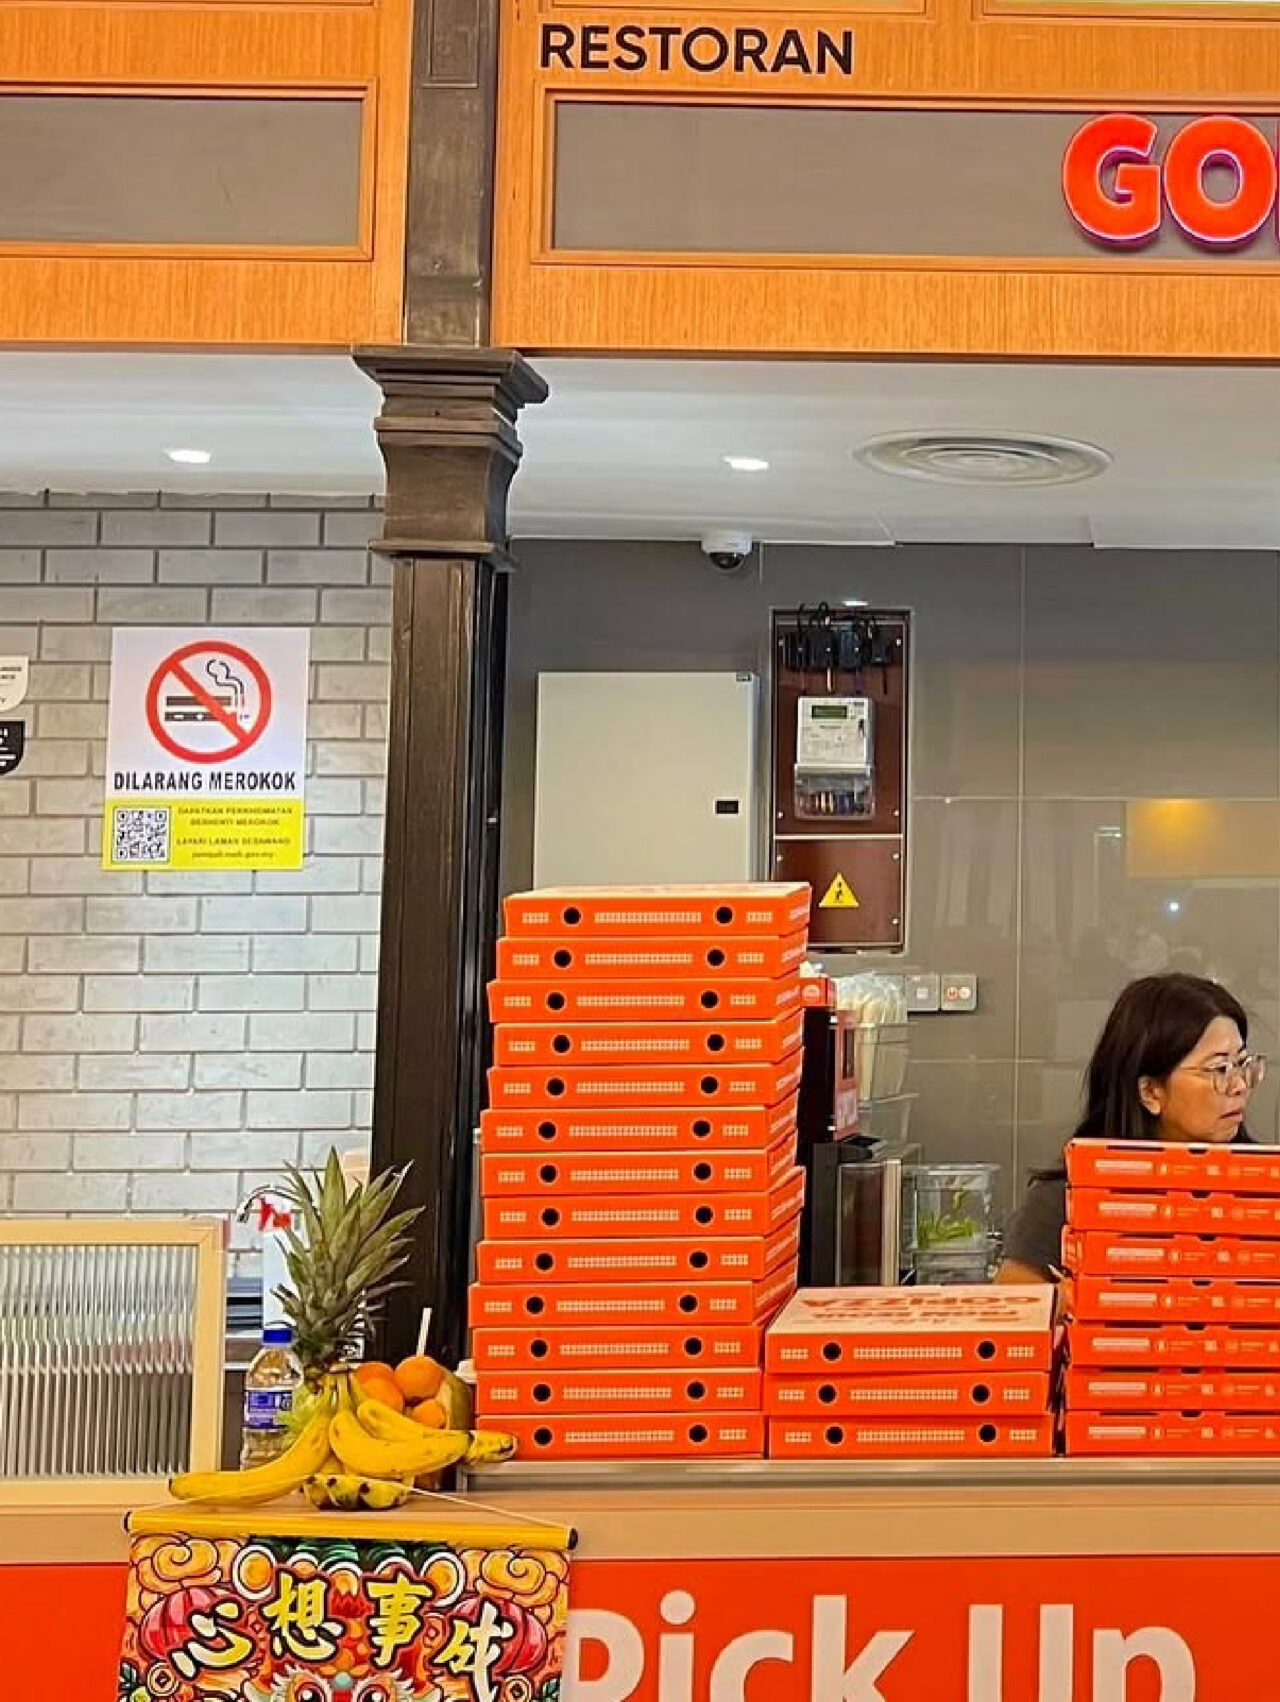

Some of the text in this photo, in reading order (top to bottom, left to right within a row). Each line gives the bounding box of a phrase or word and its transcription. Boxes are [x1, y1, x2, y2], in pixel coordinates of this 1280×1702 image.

[539, 24, 854, 75] RESTORAN
[114, 771, 297, 791] DILARANG MEROKOK
[171, 1570, 515, 1702] 心想事成
[560, 1590, 915, 1702] Pick
